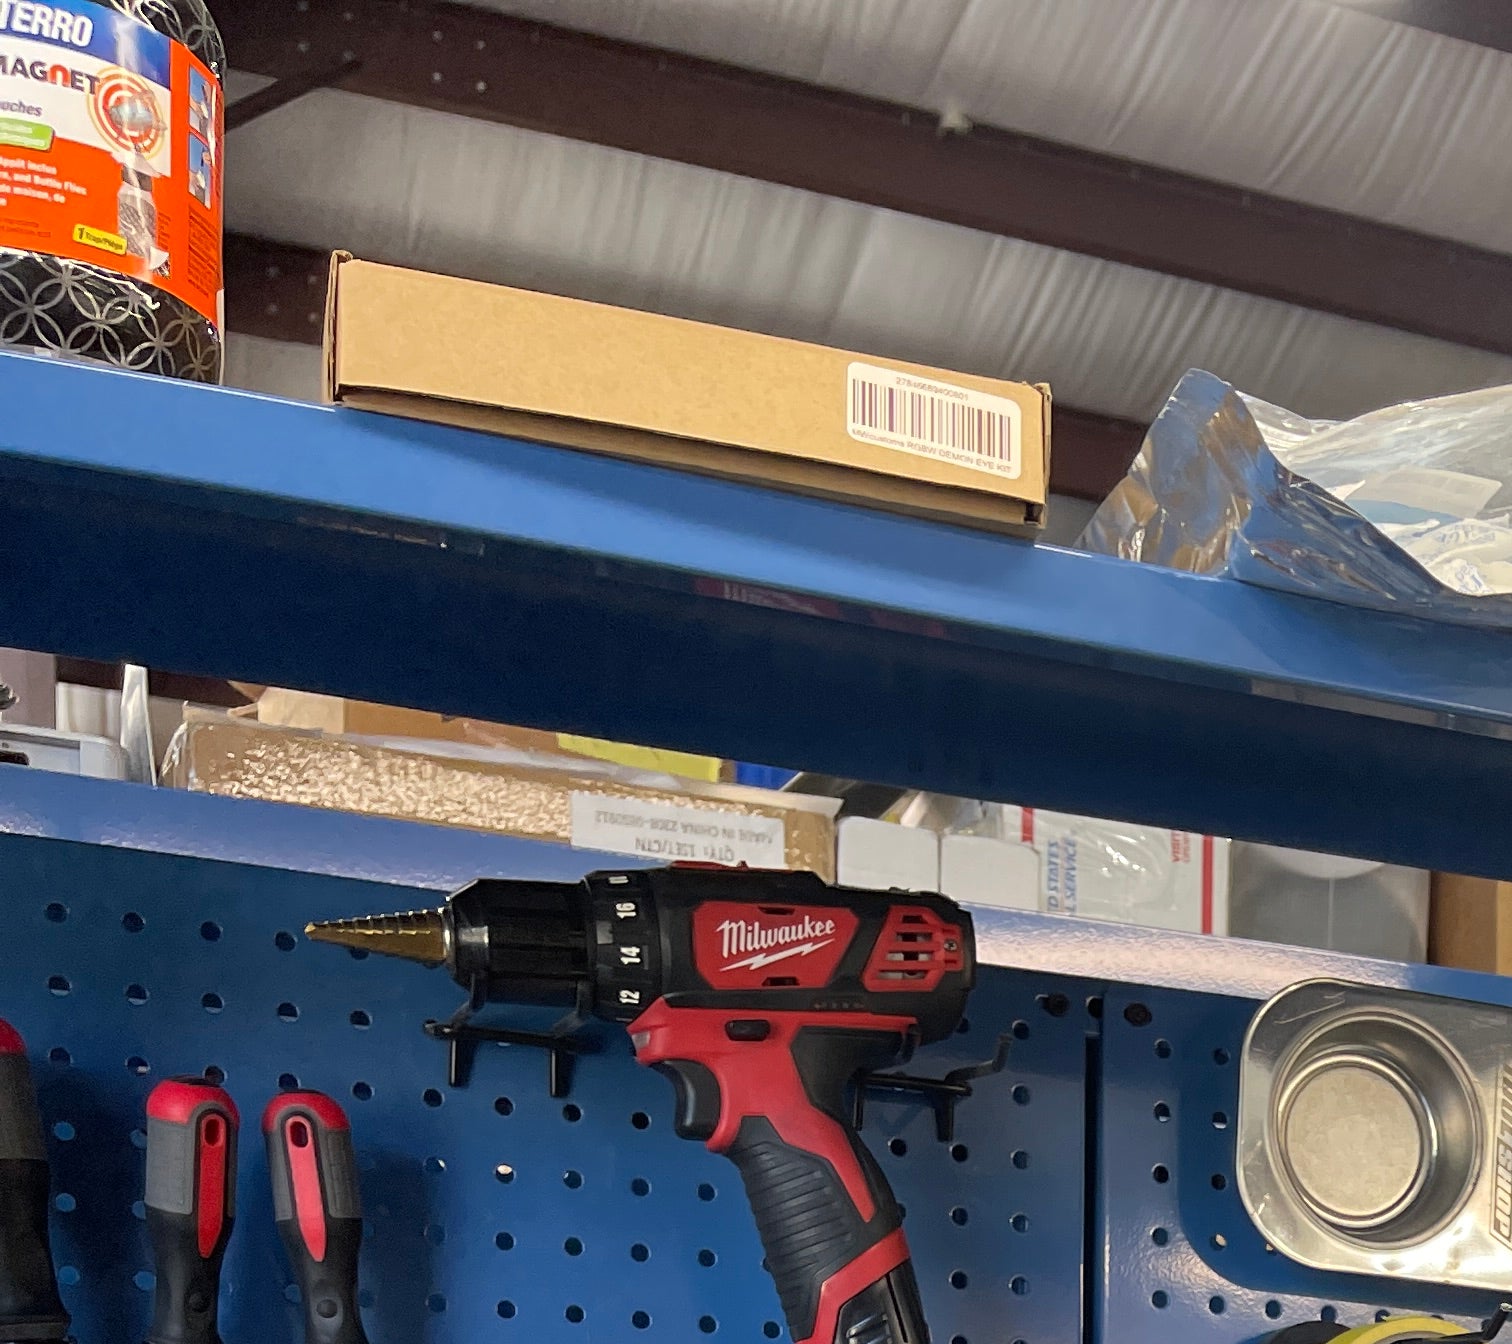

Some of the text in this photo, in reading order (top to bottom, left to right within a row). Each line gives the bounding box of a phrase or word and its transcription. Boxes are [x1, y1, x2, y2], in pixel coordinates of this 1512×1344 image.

[0, 1, 93, 47] TERRO
[1047, 839, 1060, 894] STATES
[1063, 838, 1078, 901] SERVICE
[616, 902, 636, 919] 16
[620, 946, 640, 965] 14
[716, 915, 836, 958] Milwaukee
[619, 989, 639, 1004] 12
[1495, 1143, 1512, 1239] SHOP
